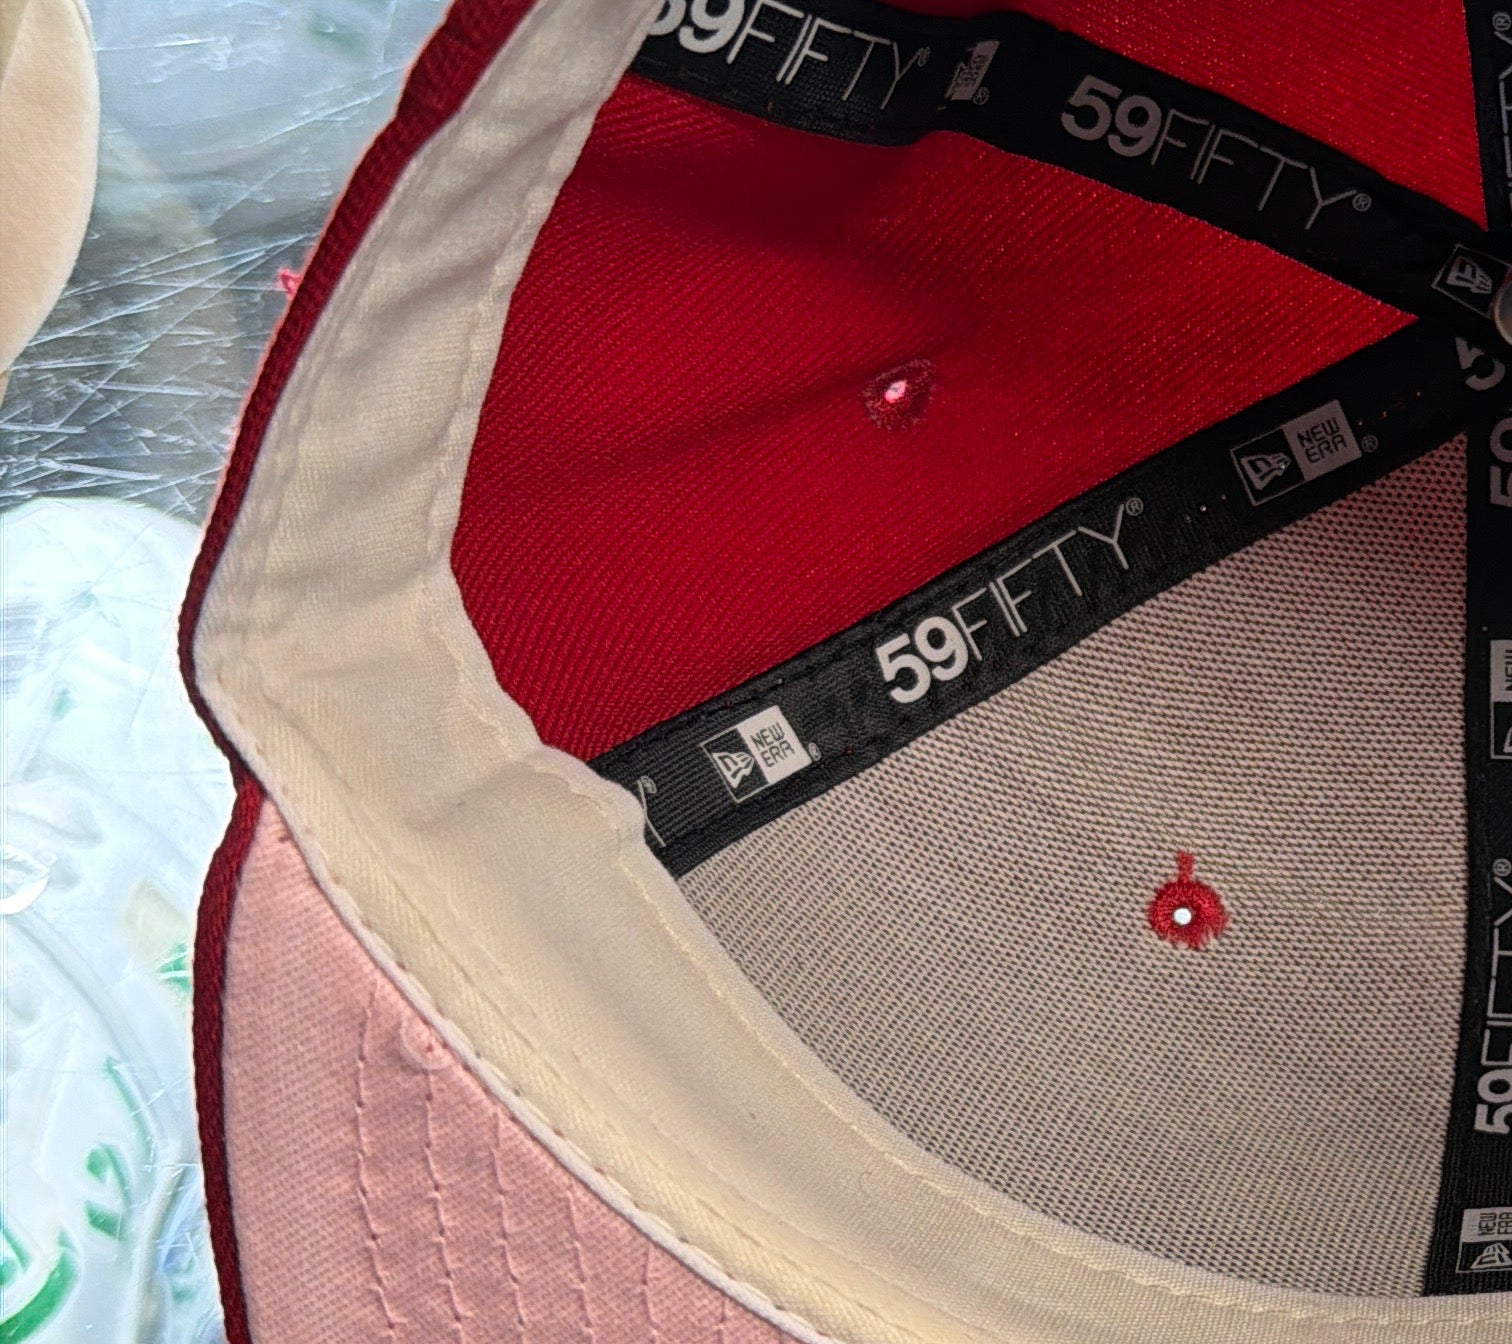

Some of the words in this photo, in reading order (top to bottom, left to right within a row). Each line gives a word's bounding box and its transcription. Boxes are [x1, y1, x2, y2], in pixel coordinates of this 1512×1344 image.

[1297, 417, 1341, 449] NEW
[1305, 434, 1347, 464] ERA
[750, 721, 785, 751] NEW
[760, 740, 796, 768] ERA
